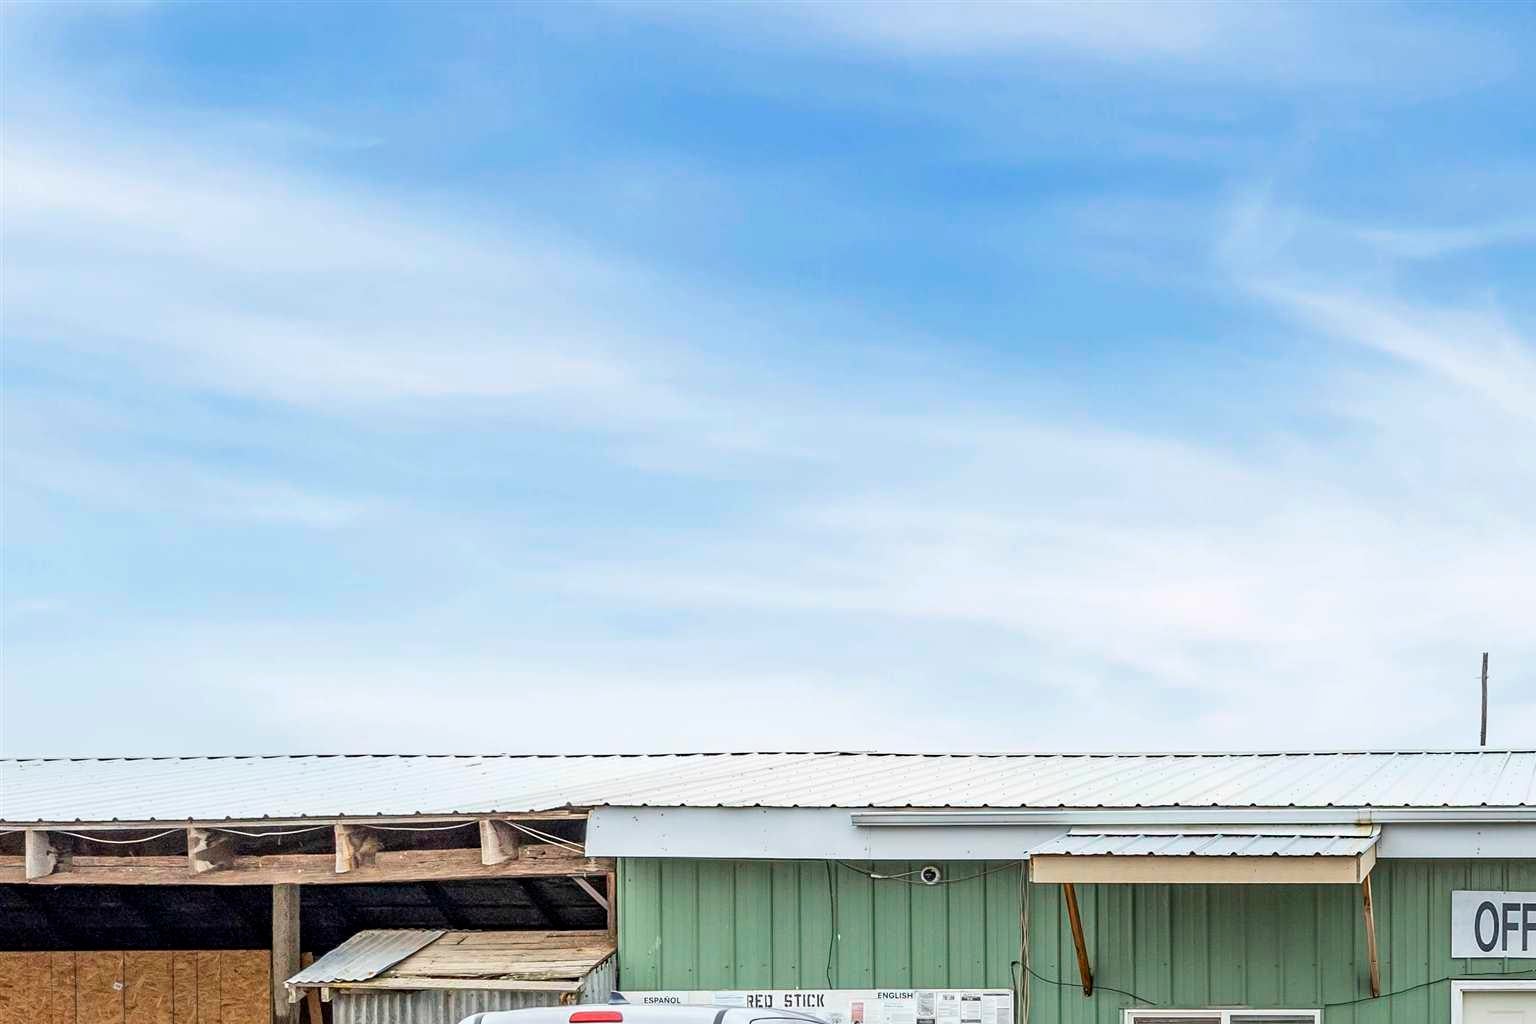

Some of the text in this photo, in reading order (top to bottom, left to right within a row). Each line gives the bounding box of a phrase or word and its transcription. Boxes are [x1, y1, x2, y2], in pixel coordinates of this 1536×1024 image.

[644, 995, 681, 1004] ESPAÑOL
[746, 993, 825, 1008] RED STICK
[877, 992, 914, 1000] ENGLISH
